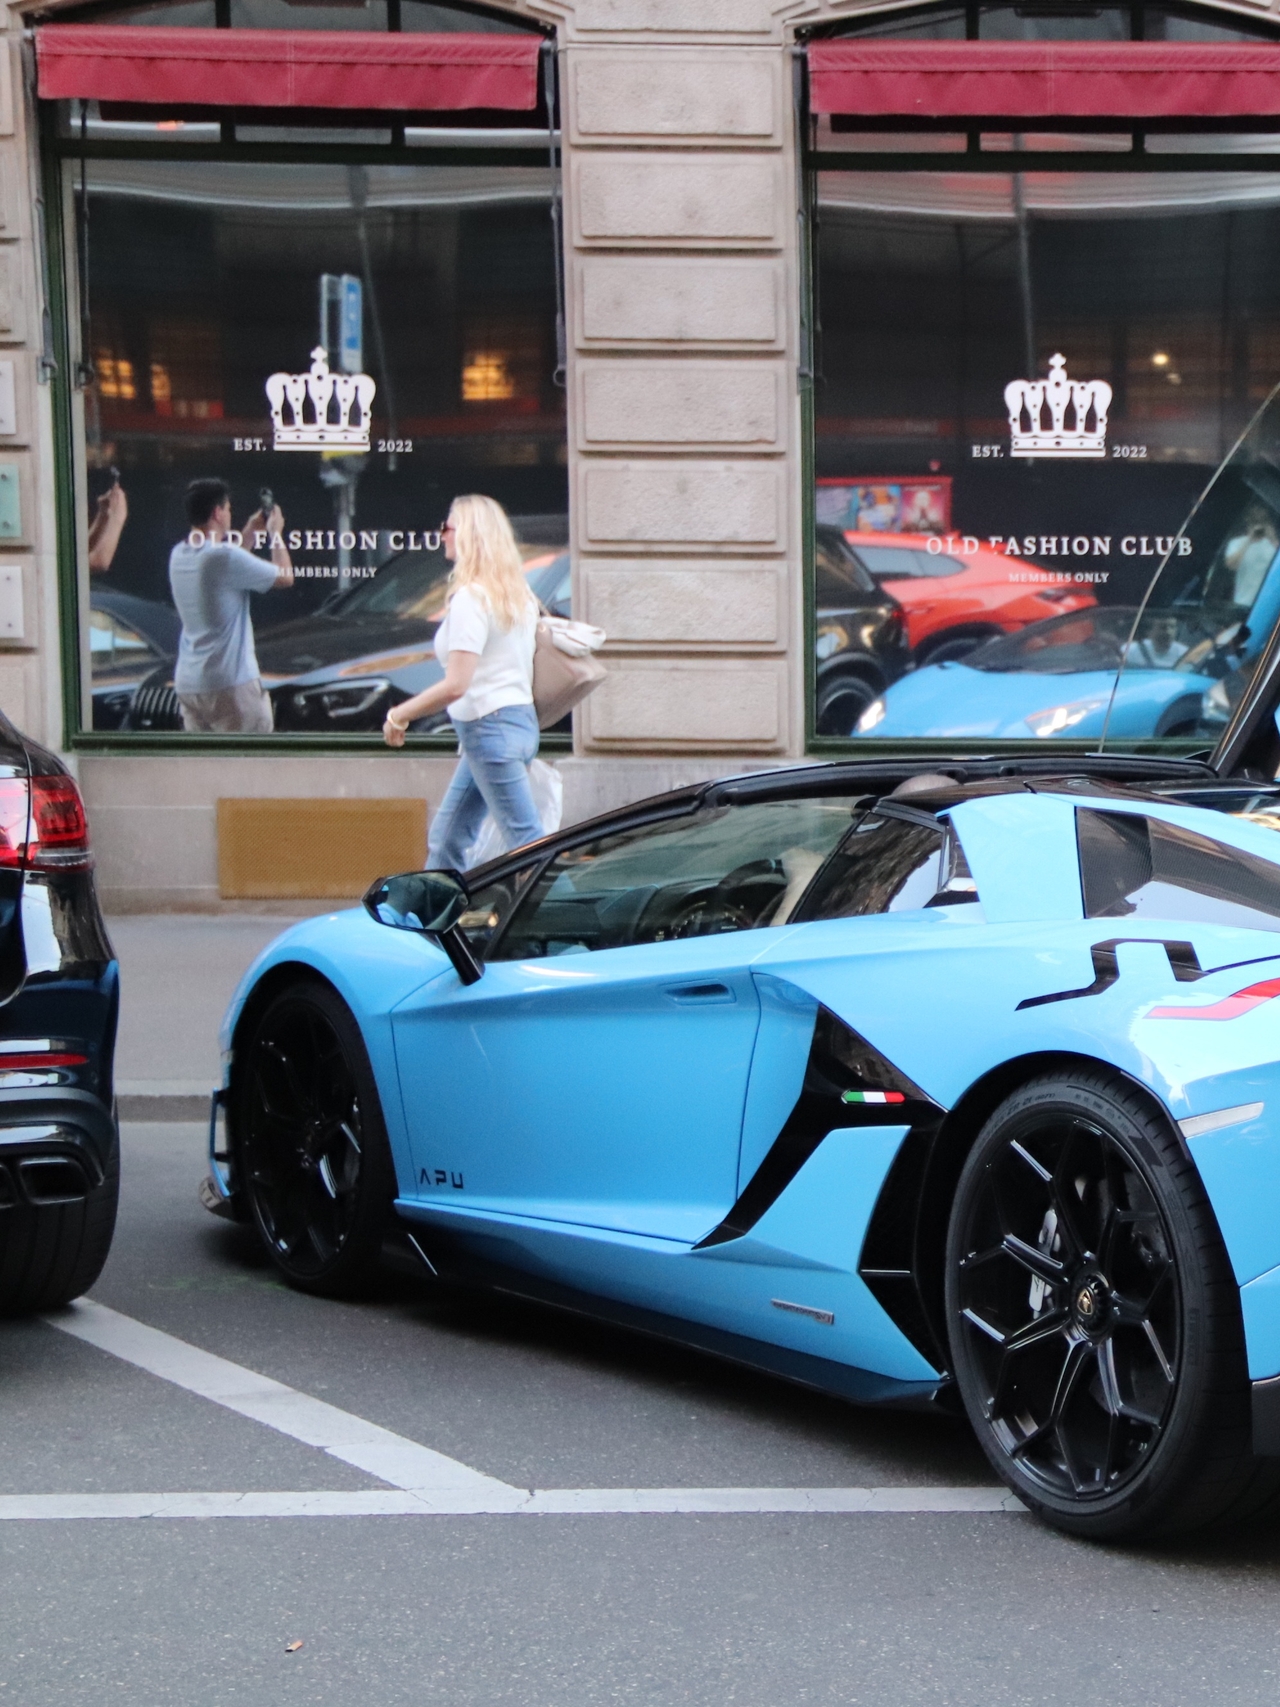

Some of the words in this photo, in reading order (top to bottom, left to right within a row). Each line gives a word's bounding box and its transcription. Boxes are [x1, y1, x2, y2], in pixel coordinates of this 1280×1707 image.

[234, 438, 266, 451] EST.
[378, 439, 413, 452] 2022
[972, 445, 1004, 458] EST.
[1112, 445, 1147, 458] 2022
[188, 530, 244, 549] OLD
[254, 530, 379, 550] FASHION
[389, 531, 441, 550] CLU
[926, 536, 979, 555] OLD
[1121, 536, 1193, 556] CLUB
[342, 566, 377, 578] ONLY
[1009, 572, 1072, 583] MEMBERS
[1074, 572, 1110, 583] ONLY
